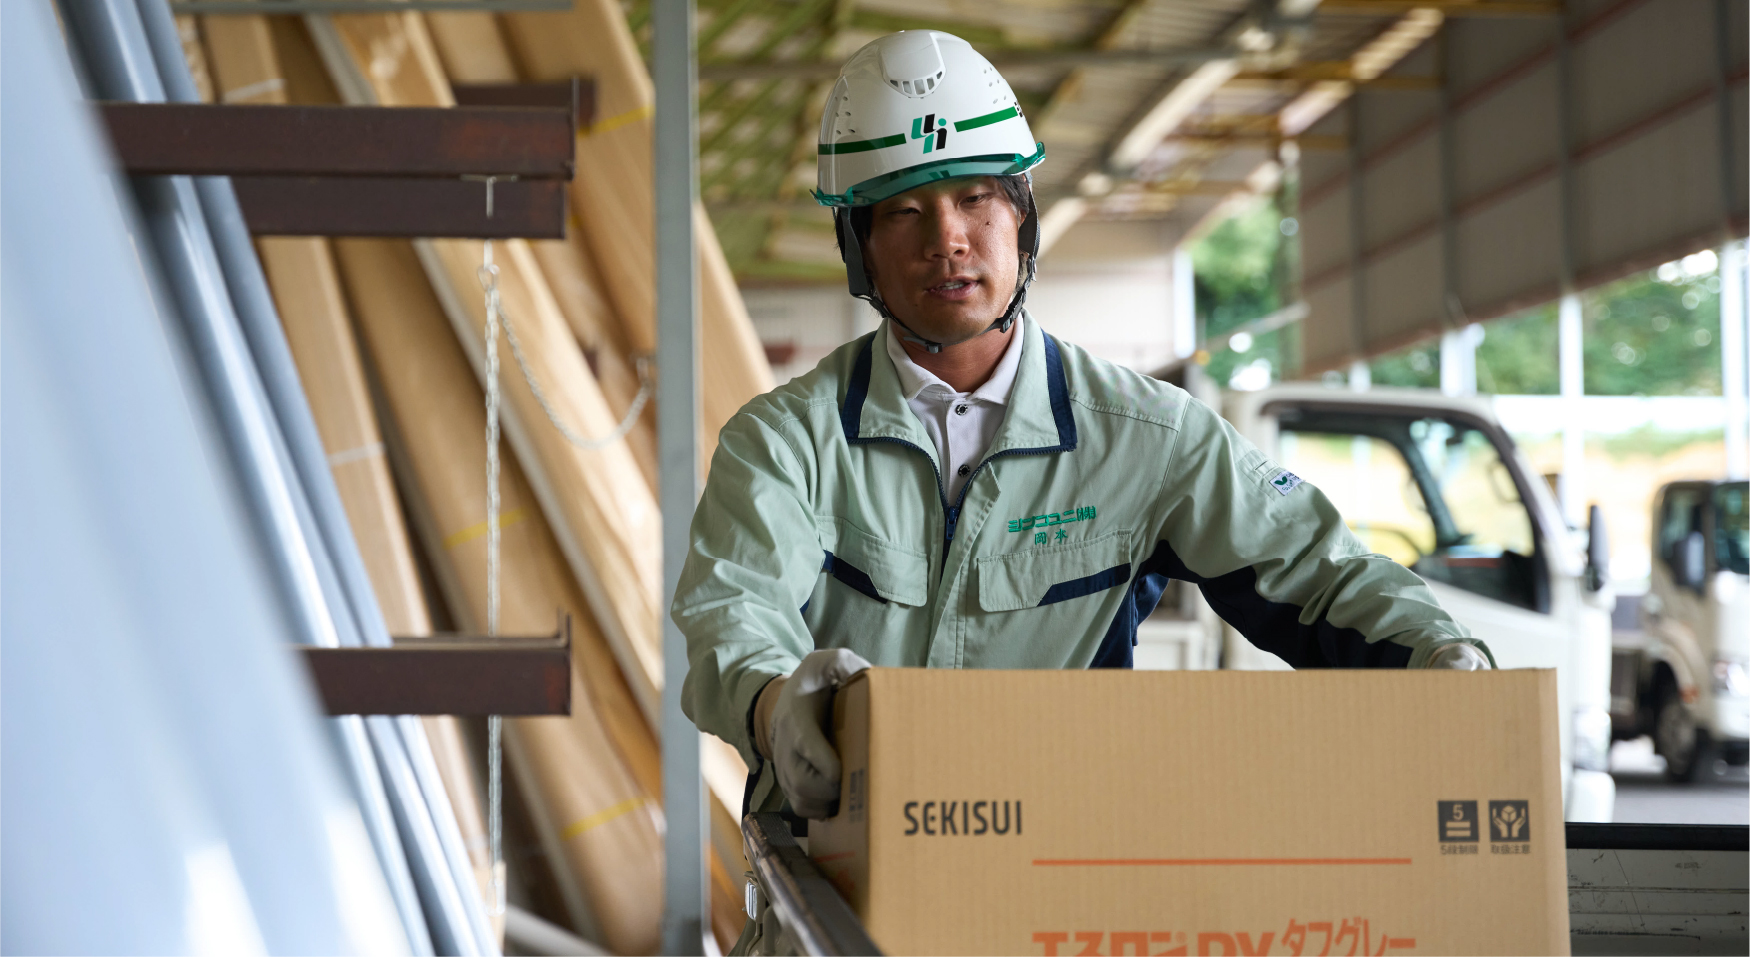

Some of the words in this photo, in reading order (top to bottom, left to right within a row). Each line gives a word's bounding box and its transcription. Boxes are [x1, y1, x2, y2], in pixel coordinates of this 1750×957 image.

[1034, 528, 1068, 545] 岡本
[904, 801, 1022, 836] SEKISUI
[1452, 804, 1464, 820] 5
